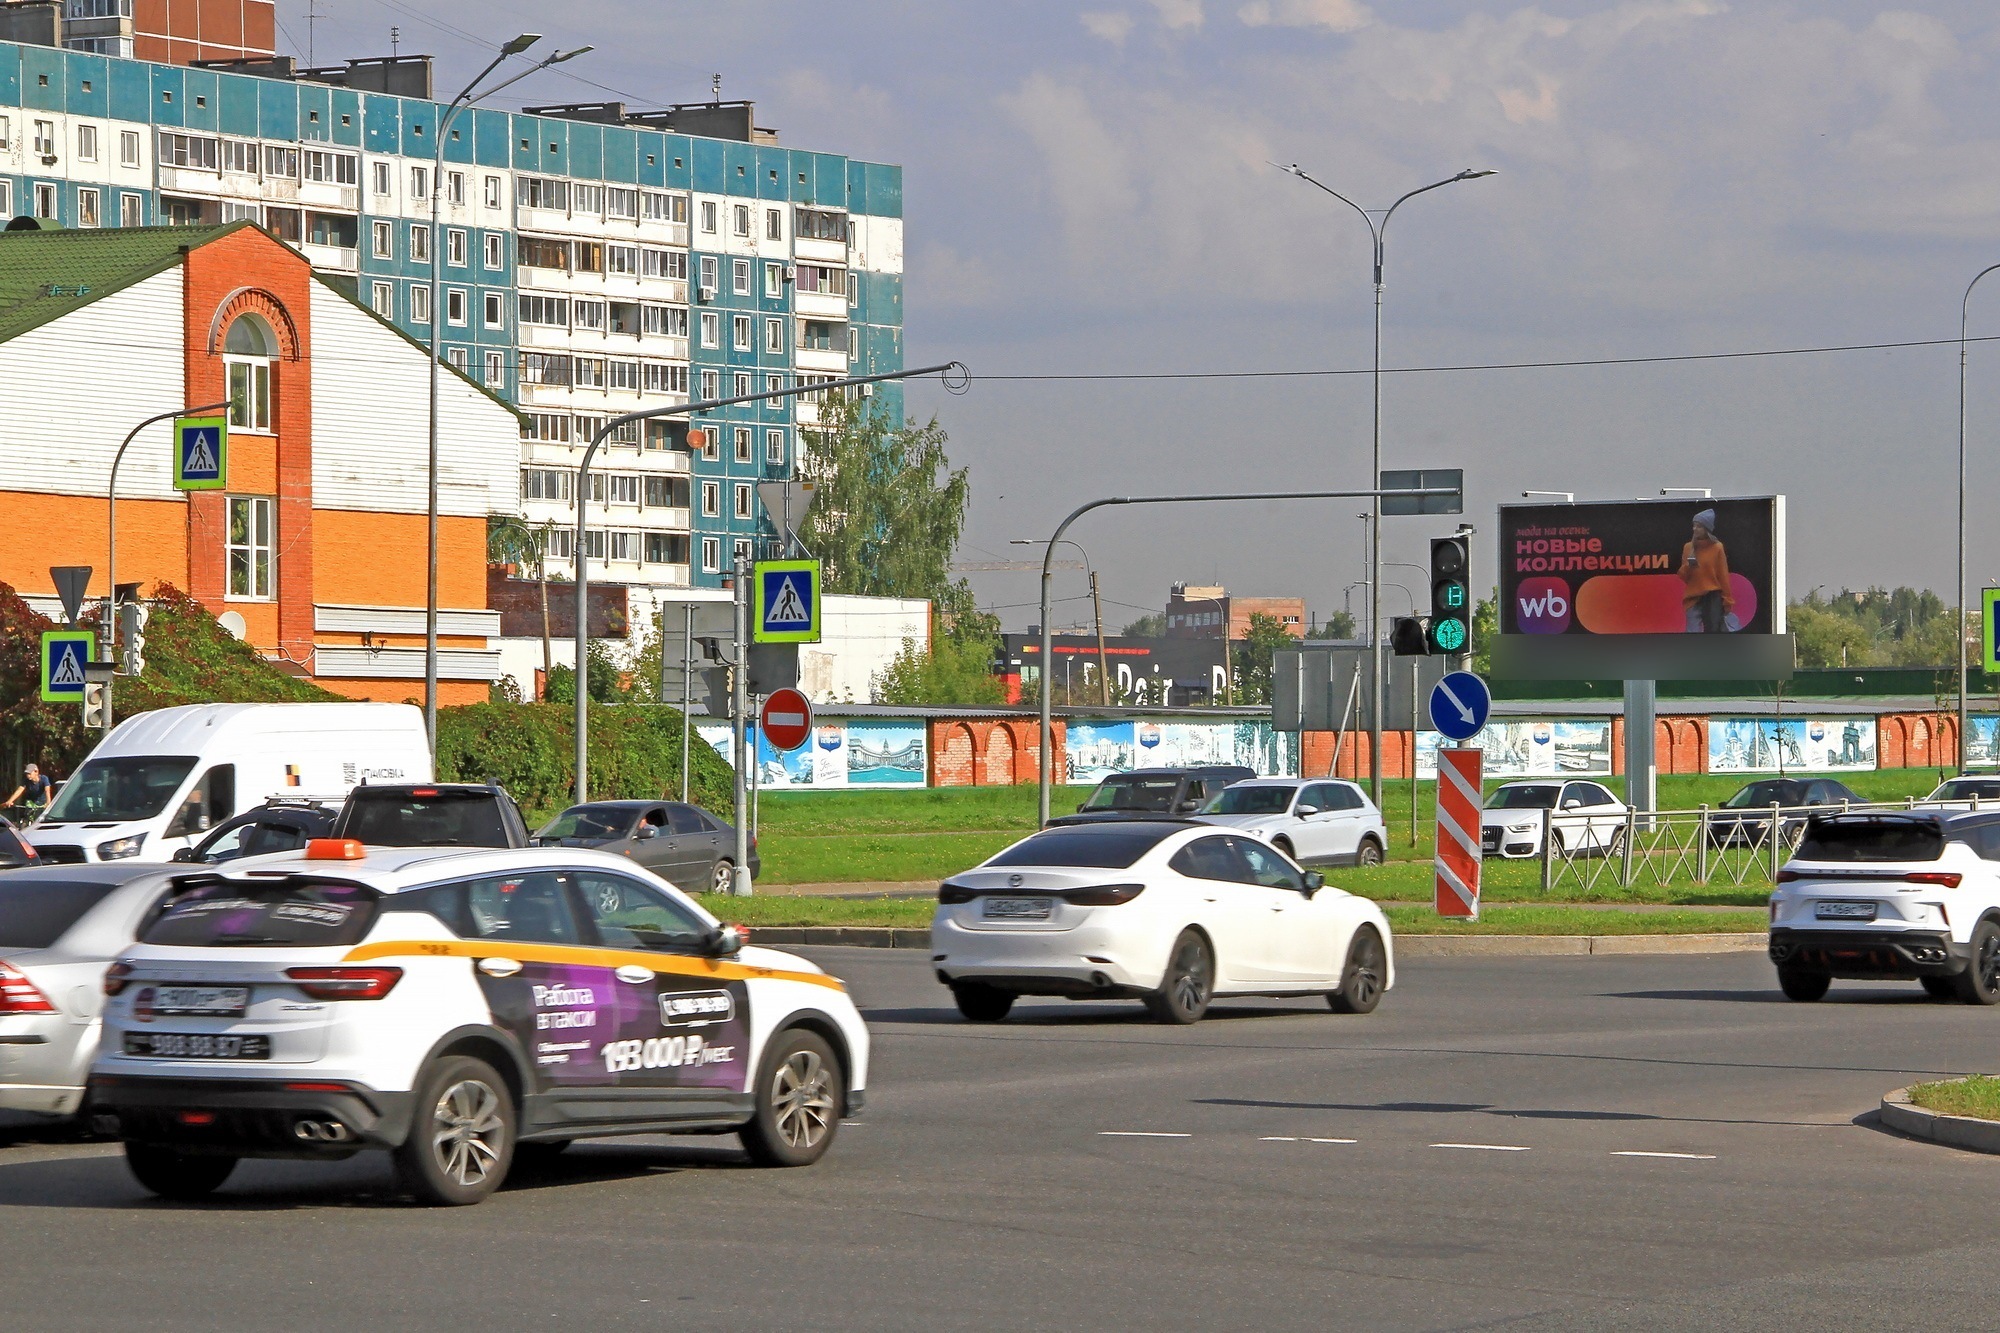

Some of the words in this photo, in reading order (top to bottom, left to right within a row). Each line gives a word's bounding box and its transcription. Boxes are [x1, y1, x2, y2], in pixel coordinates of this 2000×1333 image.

[1544, 526, 1557, 536] на
[1516, 537, 1603, 554] новые
[1516, 554, 1670, 572] коллекции
[1519, 588, 1568, 618] wb
[532, 983, 596, 1007] Работа
[536, 1012, 550, 1030] в
[549, 1011, 597, 1029] такси
